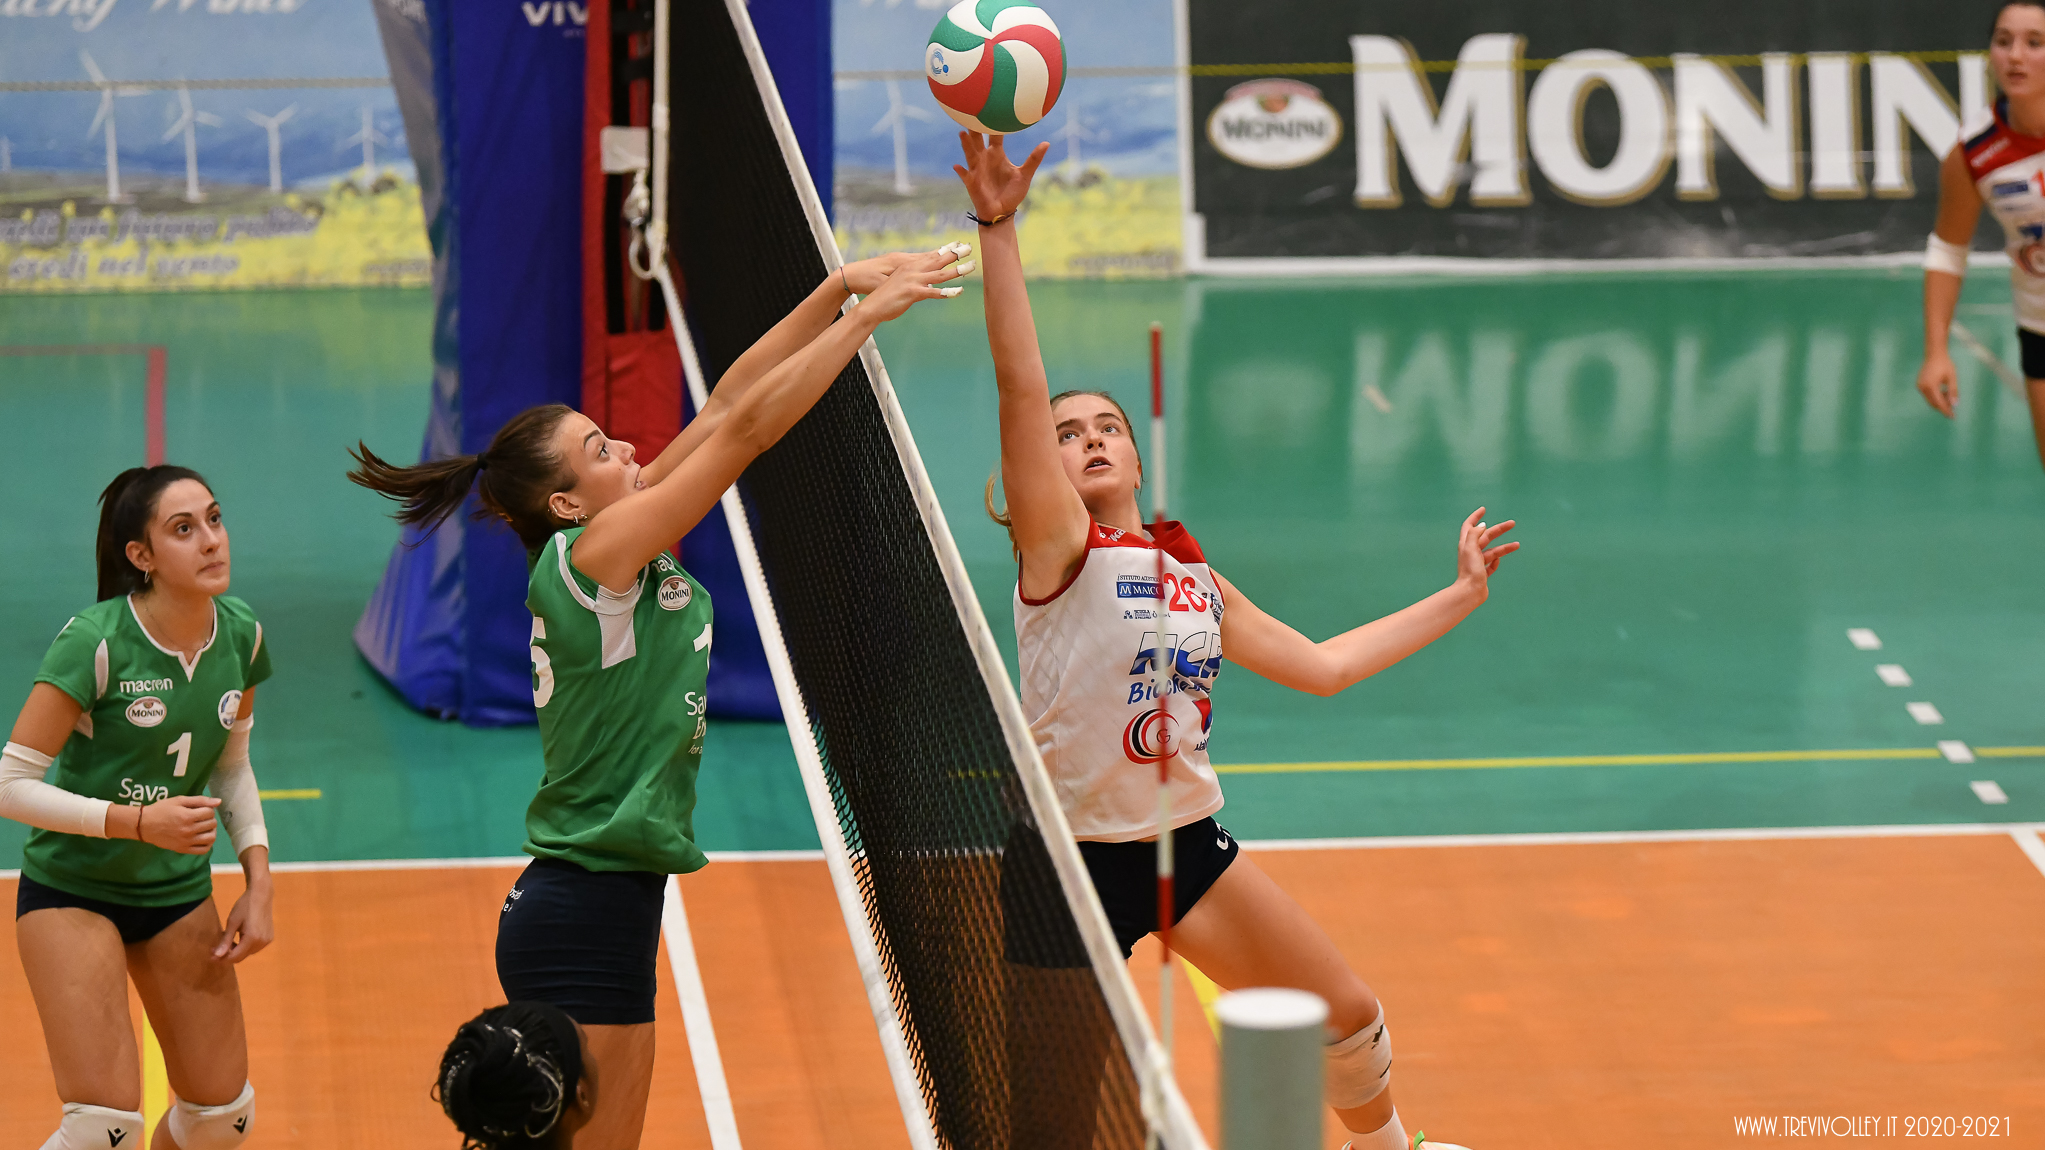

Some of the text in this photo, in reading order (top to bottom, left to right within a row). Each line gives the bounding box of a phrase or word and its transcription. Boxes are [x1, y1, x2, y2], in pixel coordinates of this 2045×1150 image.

[661, 588, 689, 602] MONINI
[1163, 572, 1207, 613] 26
[119, 678, 173, 694] macron
[131, 708, 164, 718] MONINI
[166, 732, 192, 777] 1
[118, 777, 169, 802] Sava
